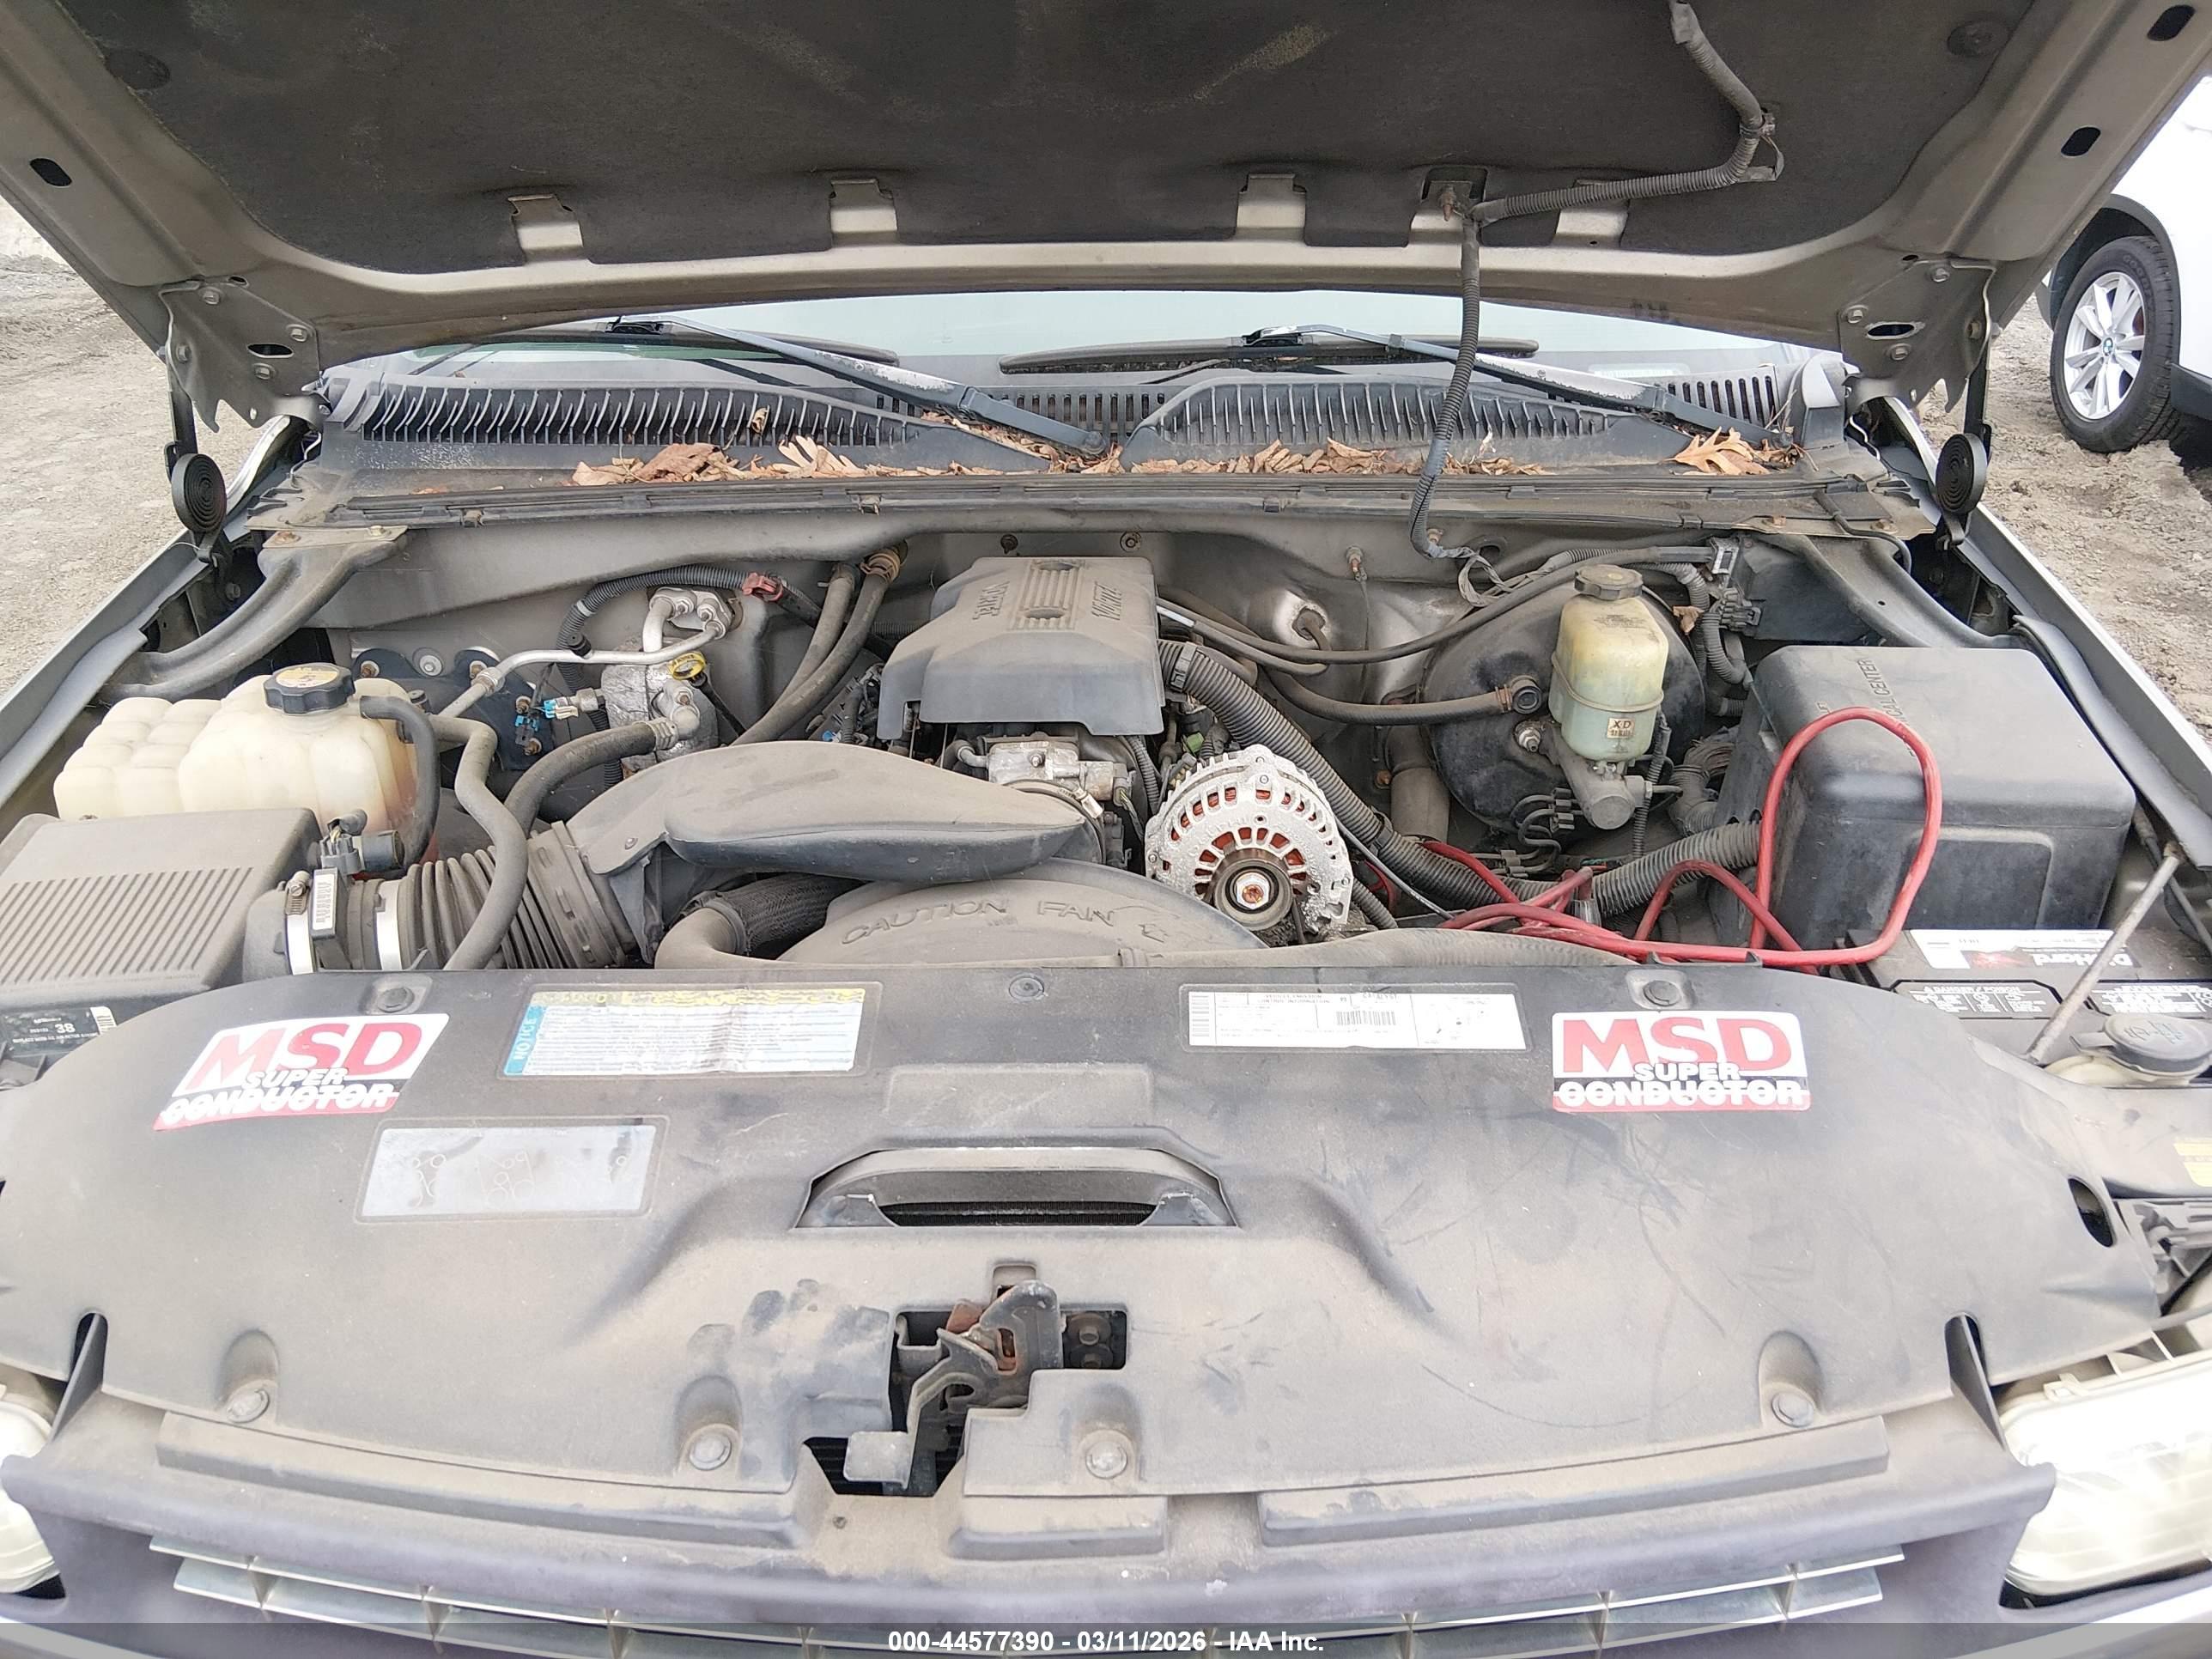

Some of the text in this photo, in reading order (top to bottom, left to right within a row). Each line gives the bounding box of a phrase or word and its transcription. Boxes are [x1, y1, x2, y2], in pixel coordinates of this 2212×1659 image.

[1856, 659, 1890, 696] CENTER
[842, 898, 1115, 945] CAUTION FAN
[54, 1023, 76, 1034] 38
[513, 1017, 537, 1060] NOTICE
[1563, 1017, 1792, 1073] MSD
[185, 1022, 422, 1091] MSD
[1633, 1061, 1741, 1082] SUPER
[241, 1067, 349, 1090] SUPER
[1554, 1079, 1808, 1108] CONDUCTOR
[161, 1083, 400, 1125] CONDUCTOR
